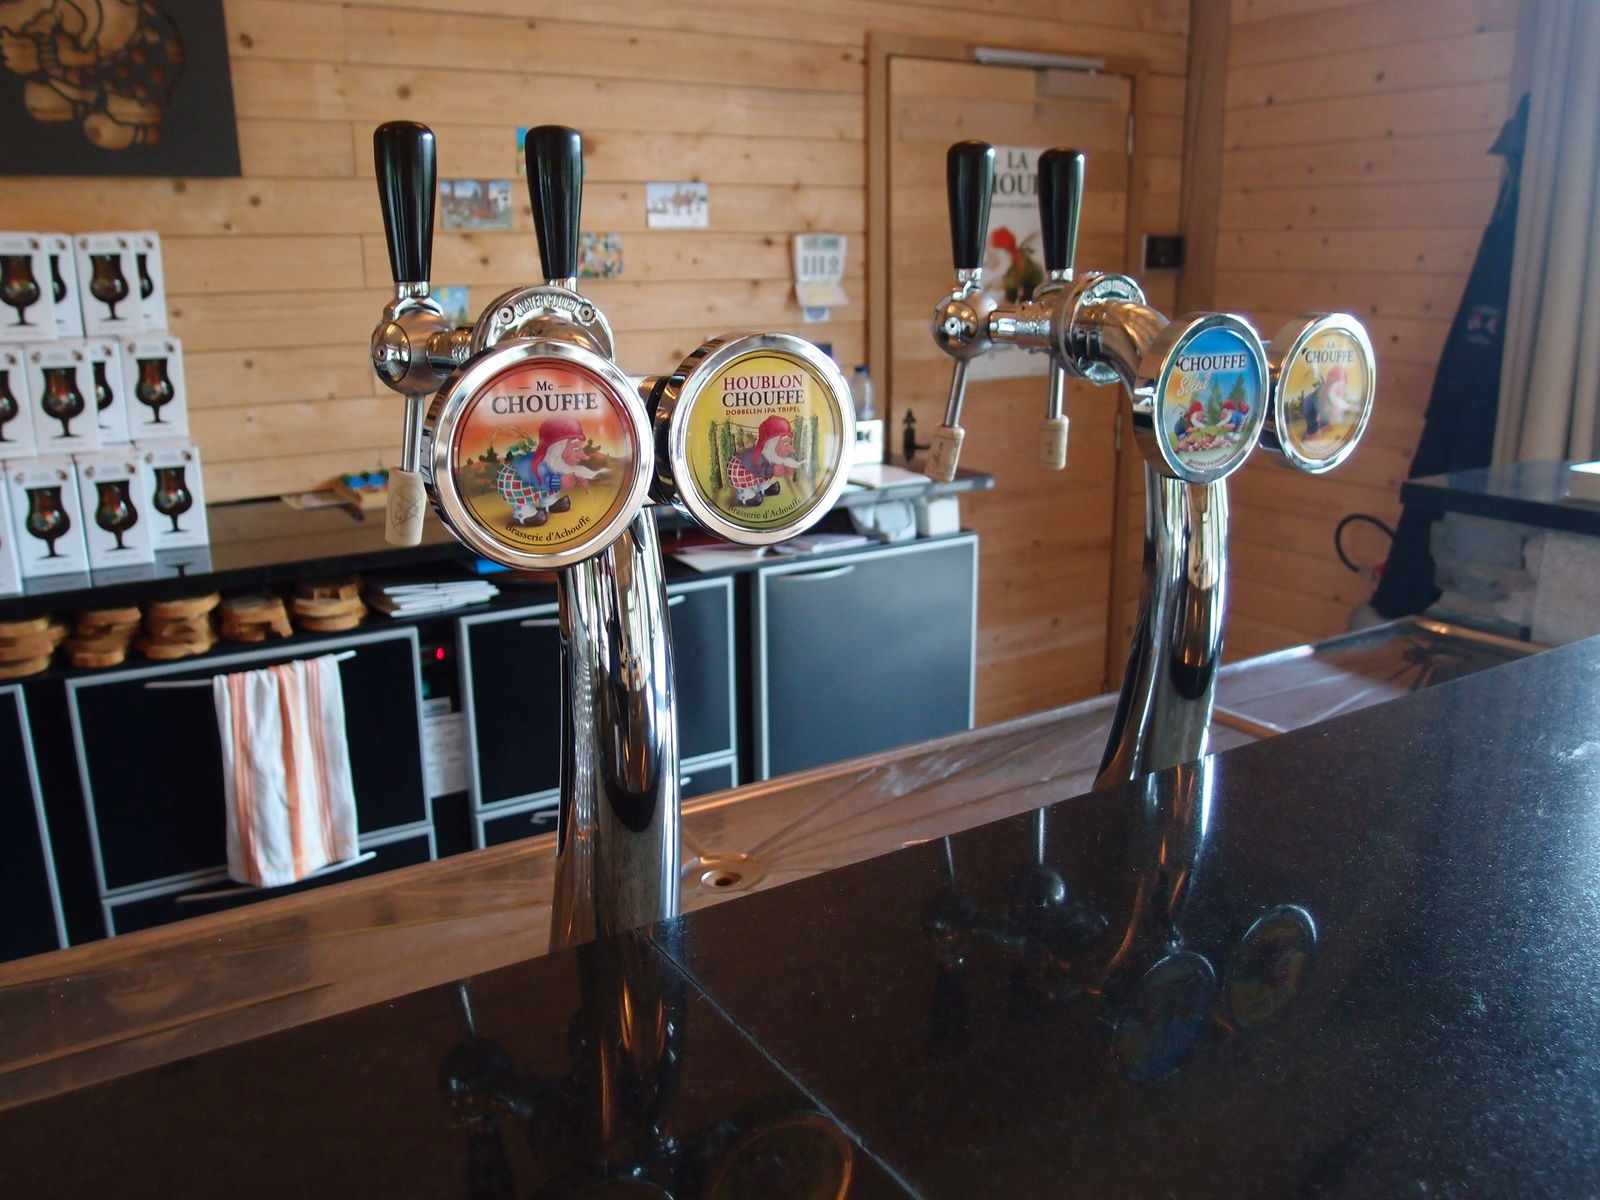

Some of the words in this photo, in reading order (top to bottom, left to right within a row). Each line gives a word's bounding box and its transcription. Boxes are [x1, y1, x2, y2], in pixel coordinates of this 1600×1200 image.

[1007, 151, 1028, 169] LA
[1180, 353, 1247, 373] CHOUFFE
[1305, 350, 1354, 363] CHOUFFE
[536, 380, 554, 391] Mc
[723, 374, 803, 391] HOUBLON
[491, 392, 599, 414] CHOUFFE
[722, 389, 804, 408] CHOUFFE
[725, 407, 763, 416] DOBBELEN
[778, 405, 801, 414] TRIPEL
[728, 503, 761, 520] Brasserie
[762, 497, 802, 519] d'Achouffe
[504, 523, 544, 542] Brasserie
[545, 514, 591, 541] d'Achouffe
